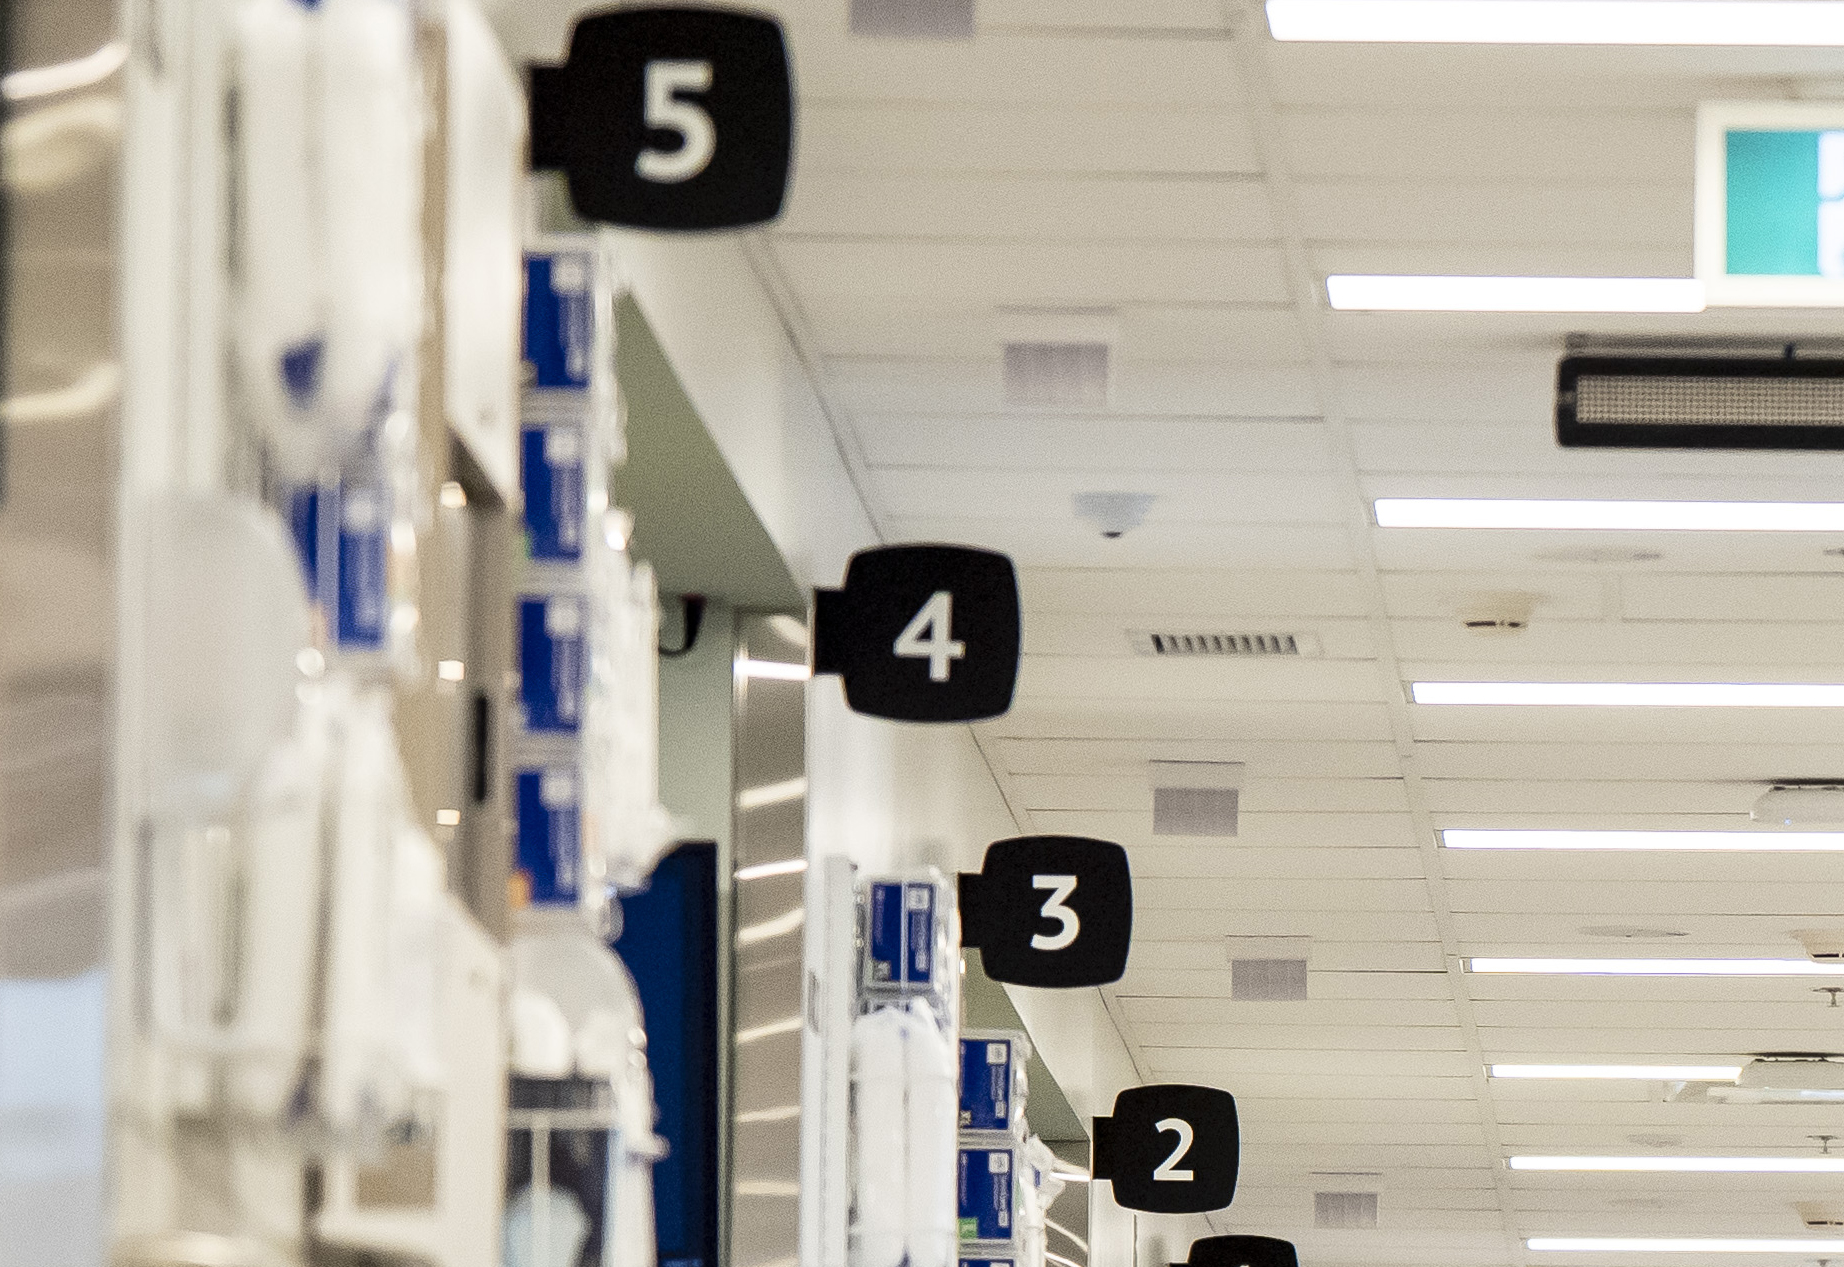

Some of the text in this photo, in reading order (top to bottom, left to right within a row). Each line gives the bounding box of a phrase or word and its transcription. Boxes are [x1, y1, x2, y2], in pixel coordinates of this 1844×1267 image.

[636, 61, 716, 181] 5
[893, 591, 965, 682] 4
[1030, 874, 1081, 951] 3
[1153, 1117, 1194, 1182] 2
